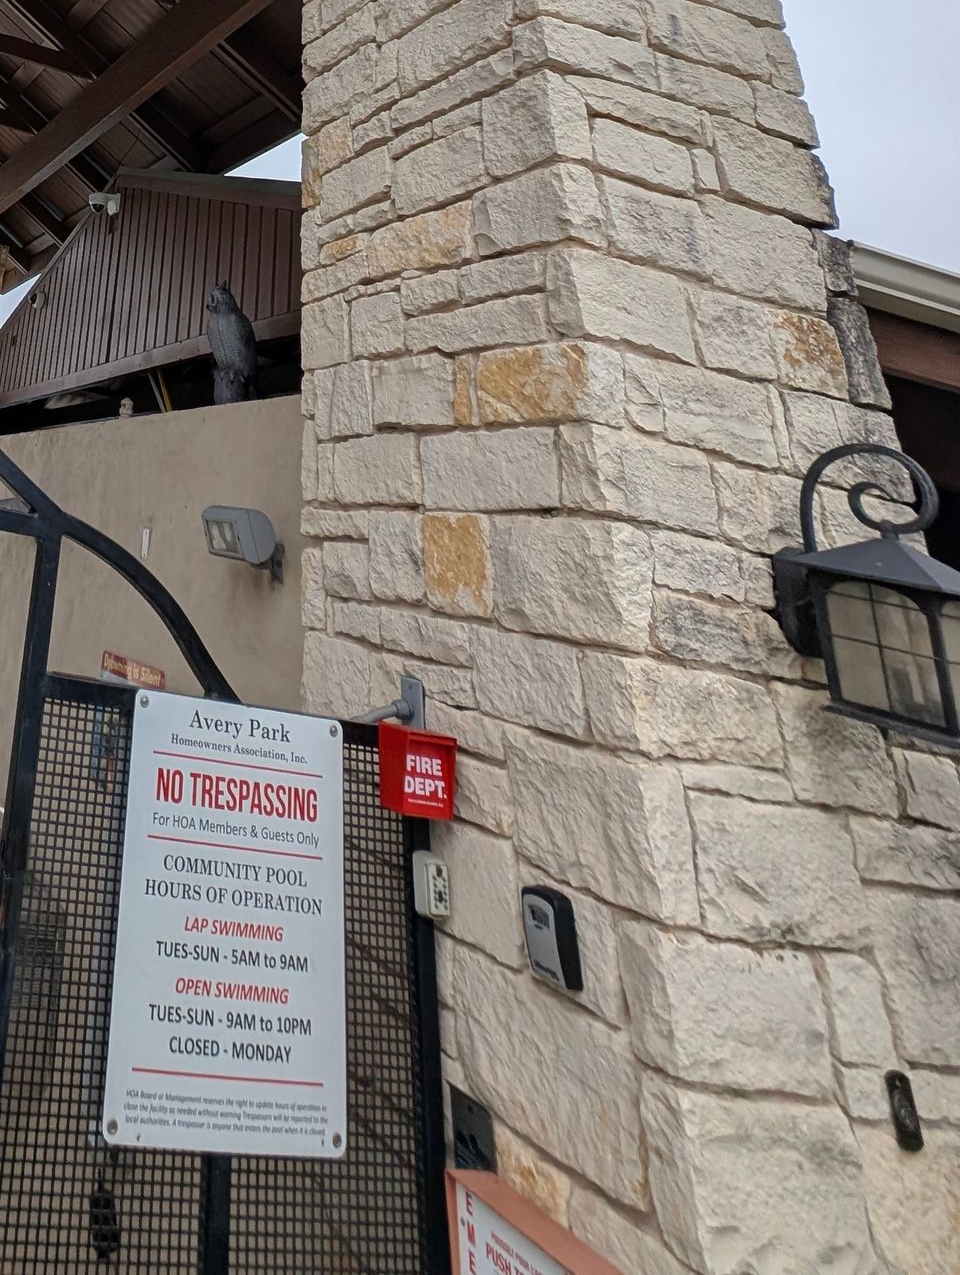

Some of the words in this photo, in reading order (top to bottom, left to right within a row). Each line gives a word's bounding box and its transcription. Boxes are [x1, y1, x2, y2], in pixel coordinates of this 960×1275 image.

[133, 663, 139, 679] is
[190, 709, 243, 739] Avery
[249, 719, 291, 743] Park
[171, 733, 232, 754] Homeowners
[234, 744, 289, 763] Association,
[291, 752, 308, 764] Inc.
[406, 754, 443, 776] FIRE
[156, 767, 184, 804] NO
[190, 772, 318, 822] TRESPASSING
[404, 775, 448, 799] DEPT.
[153, 812, 170, 826] For
[172, 815, 196, 830] HOA
[199, 819, 248, 837] Members
[250, 825, 259, 838] &
[261, 827, 294, 843] Guests
[297, 832, 320, 849] Only
[163, 854, 262, 882] COMMUNITY
[266, 867, 308, 887] POOL
[144, 878, 202, 901] HOURS
[206, 886, 228, 904] OF
[231, 889, 323, 916] OPERATION
[184, 916, 209, 934] LAP
[211, 919, 285, 942] SWIMMING
[156, 940, 220, 963] TUES-SUN
[231, 949, 260, 967] 5AM
[264, 953, 277, 969] to
[280, 954, 309, 972] 9AM
[175, 977, 212, 997] OPEN
[214, 981, 290, 1005] SWIMMING
[149, 1003, 214, 1027] TUES-SUN
[226, 1012, 256, 1031] 9AM
[260, 1016, 273, 1032] to
[277, 1017, 312, 1036] 10PM
[169, 1036, 220, 1058] CLOSED
[232, 1041, 292, 1064] MONDAY
